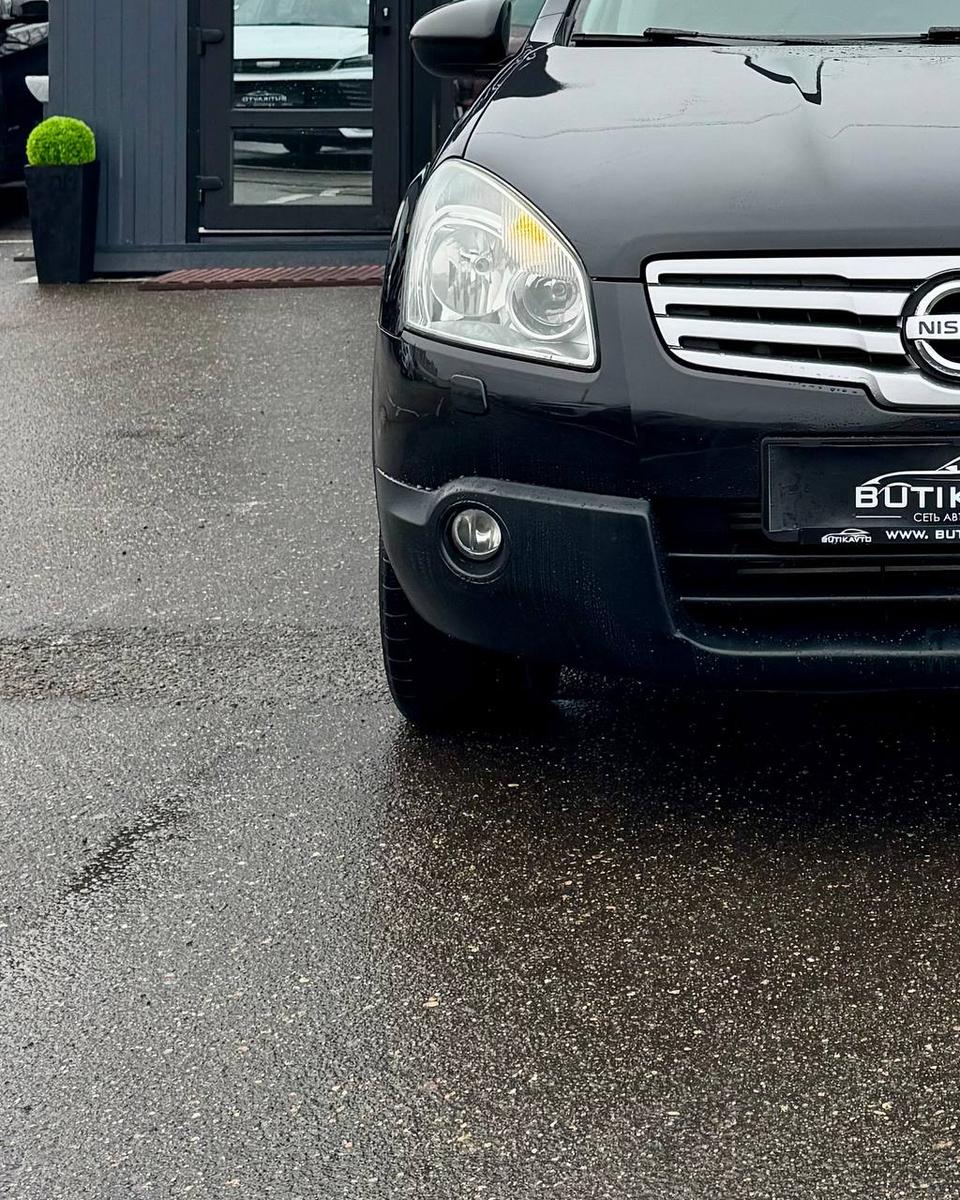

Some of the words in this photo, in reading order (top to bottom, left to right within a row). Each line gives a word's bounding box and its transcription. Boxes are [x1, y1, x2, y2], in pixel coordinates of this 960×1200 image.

[913, 512, 940, 523] СЕТЬ
[821, 535, 872, 544] BUTIKAVTO
[885, 529, 929, 540] WWW.
